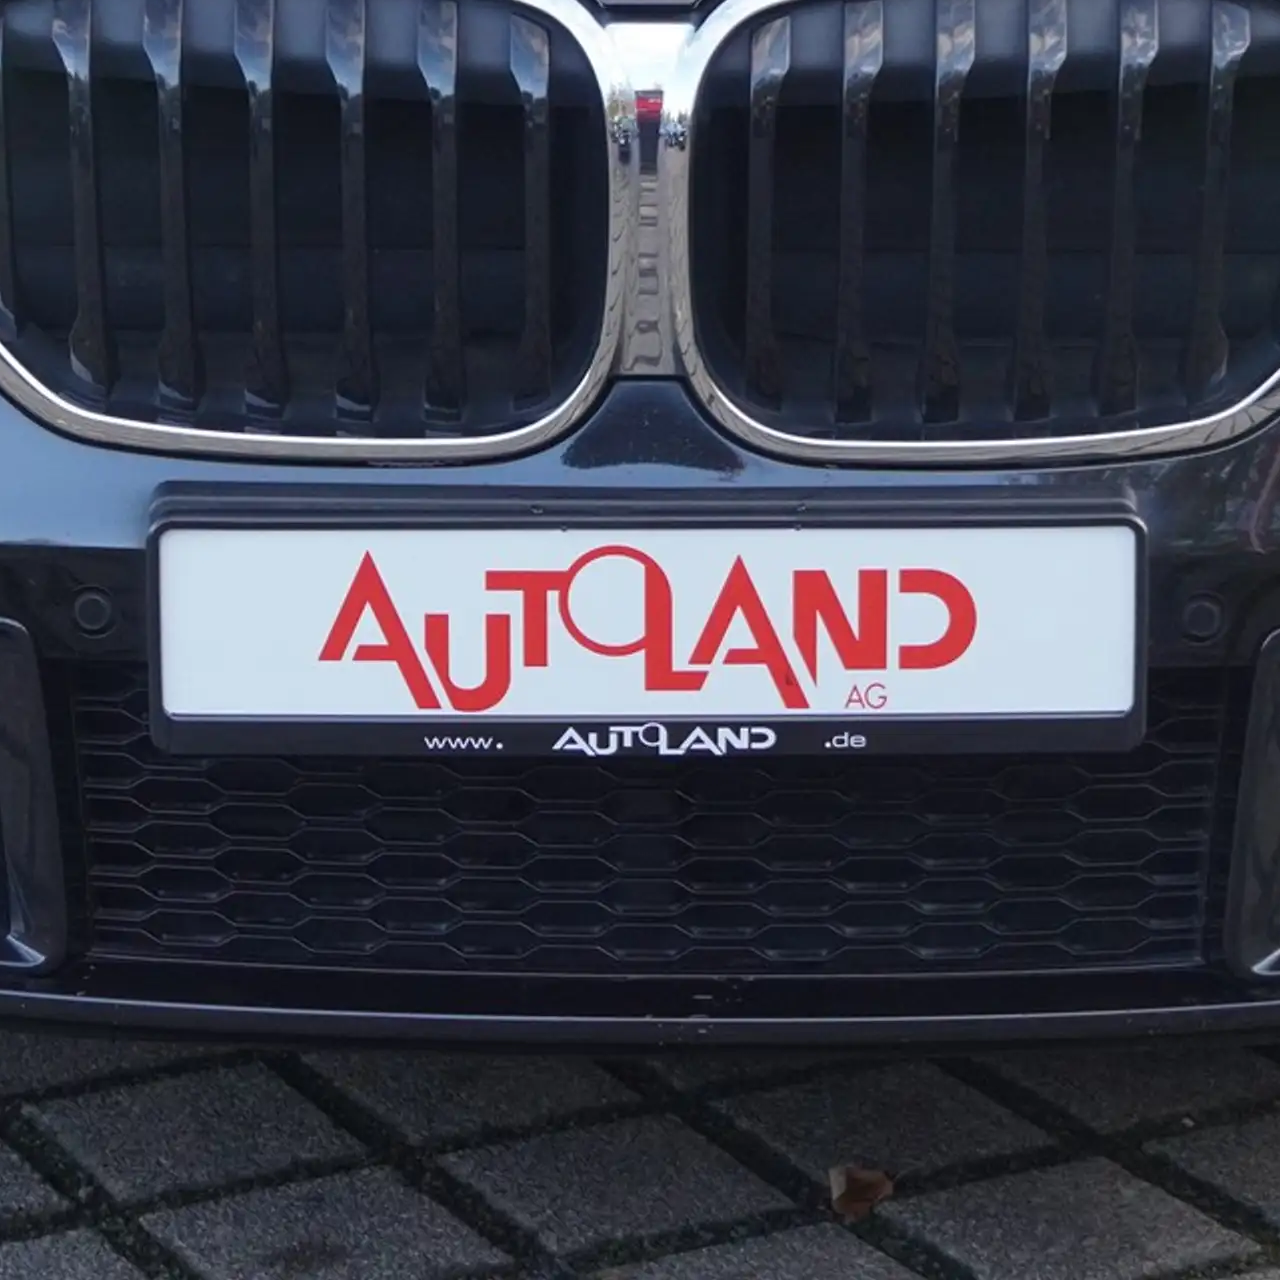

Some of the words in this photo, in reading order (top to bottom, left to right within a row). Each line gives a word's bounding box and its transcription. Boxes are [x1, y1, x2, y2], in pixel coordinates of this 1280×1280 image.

[318, 543, 977, 713] AUTOLAND
[843, 683, 888, 710] AG
[424, 735, 504, 750] www.
[552, 721, 777, 757] AUTOLAND
[825, 732, 867, 750] .de
